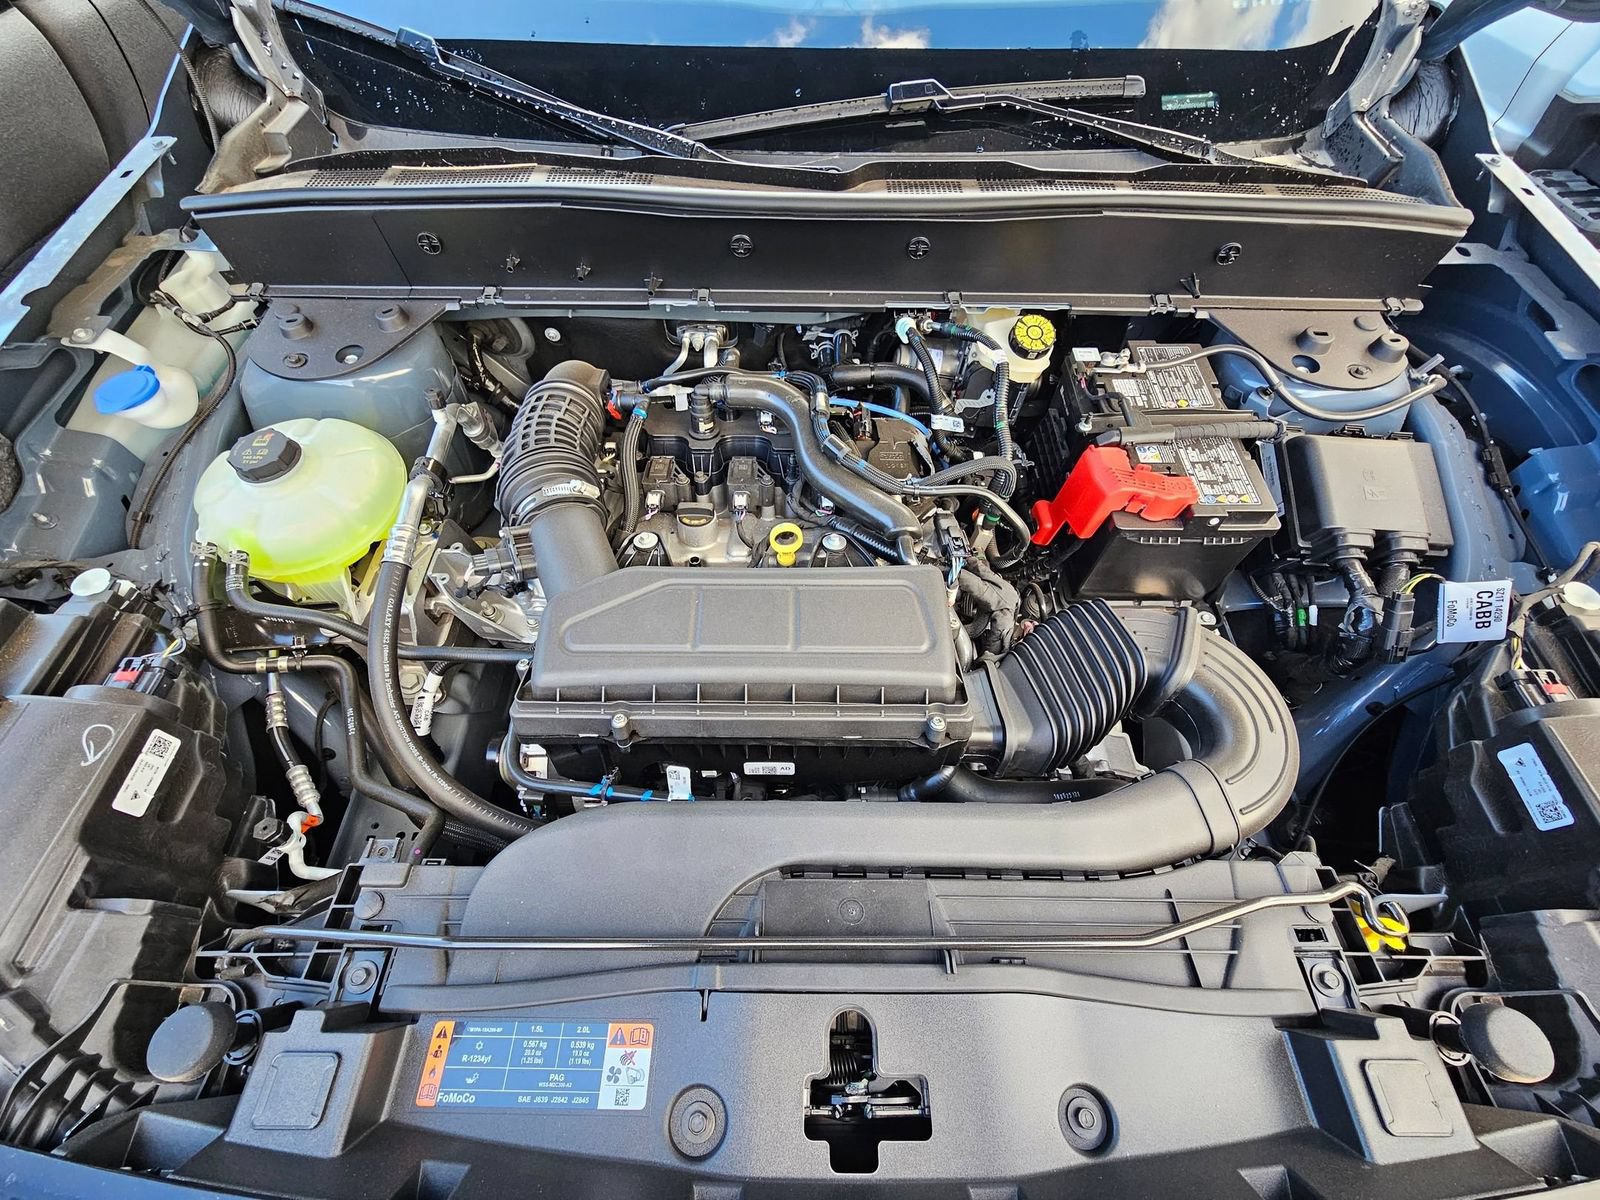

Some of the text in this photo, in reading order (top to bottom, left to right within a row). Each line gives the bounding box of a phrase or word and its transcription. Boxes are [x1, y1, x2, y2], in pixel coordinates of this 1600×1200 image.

[1447, 600, 1457, 627] FoMoCo
[1475, 591, 1493, 629] CABB
[384, 598, 395, 628] GALAXY
[395, 720, 411, 744] SUCTION
[523, 1040, 548, 1049] 0.567 kg
[587, 1041, 595, 1050] kg
[462, 1054, 491, 1063] R-1234yf
[549, 1073, 565, 1081] PAG
[437, 1092, 476, 1104] FoMoCo
[517, 1095, 531, 1103] SAE
